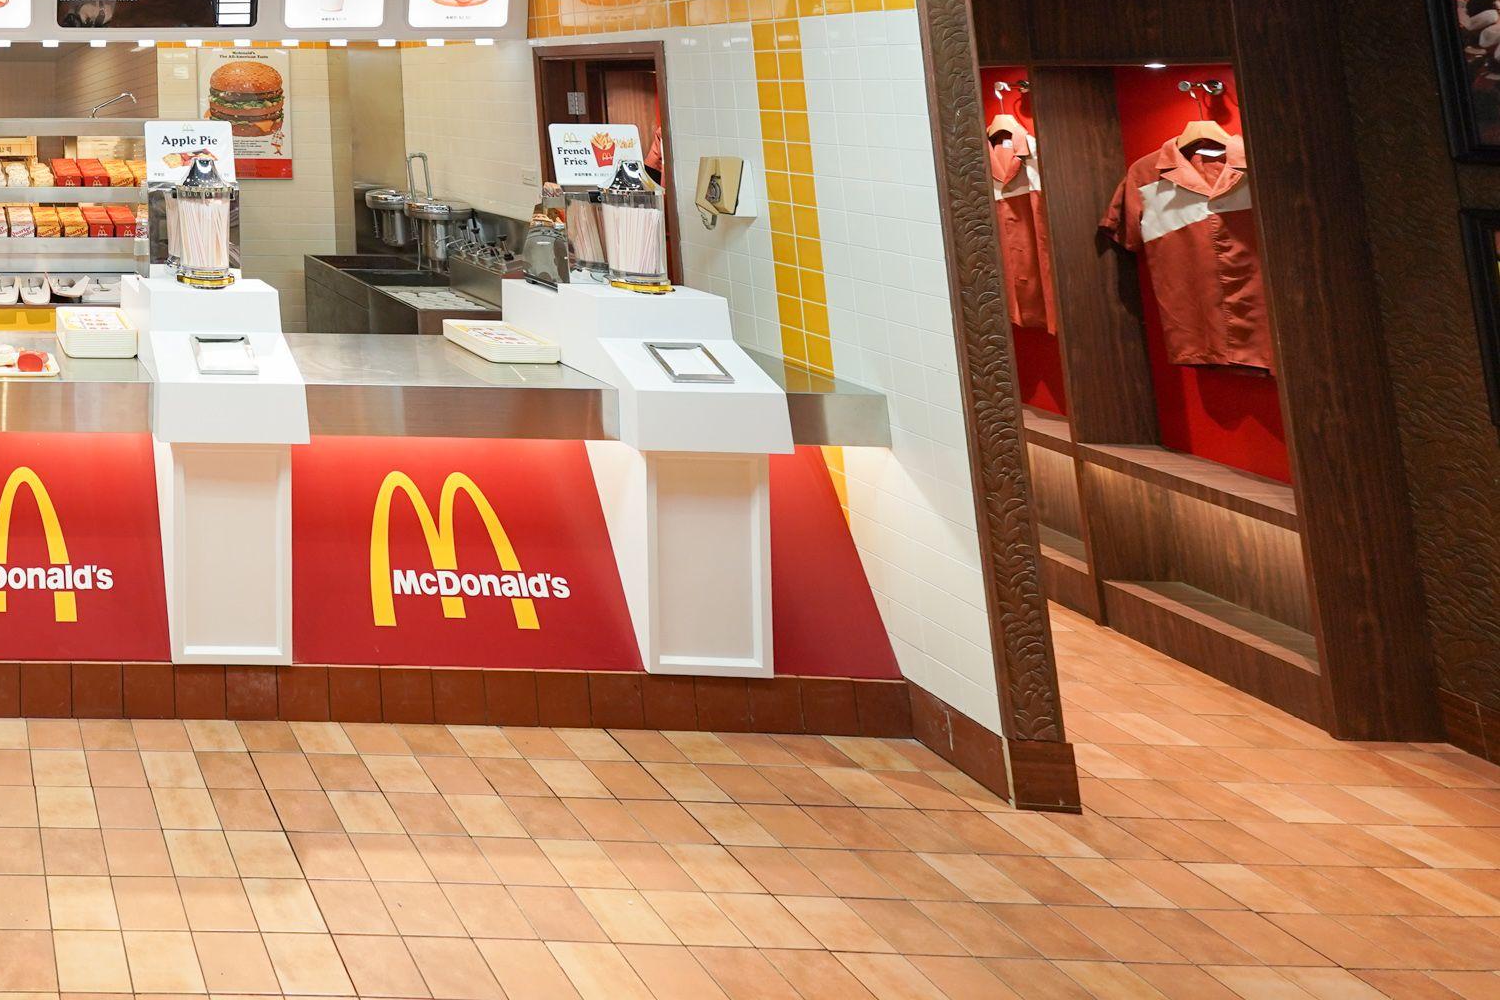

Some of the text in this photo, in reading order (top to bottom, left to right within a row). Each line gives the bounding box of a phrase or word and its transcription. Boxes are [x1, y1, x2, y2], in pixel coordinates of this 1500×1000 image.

[161, 135, 218, 147] Apple Pie
[557, 146, 591, 155] French
[563, 157, 588, 166] Fries
[392, 569, 571, 599] McDonald's
